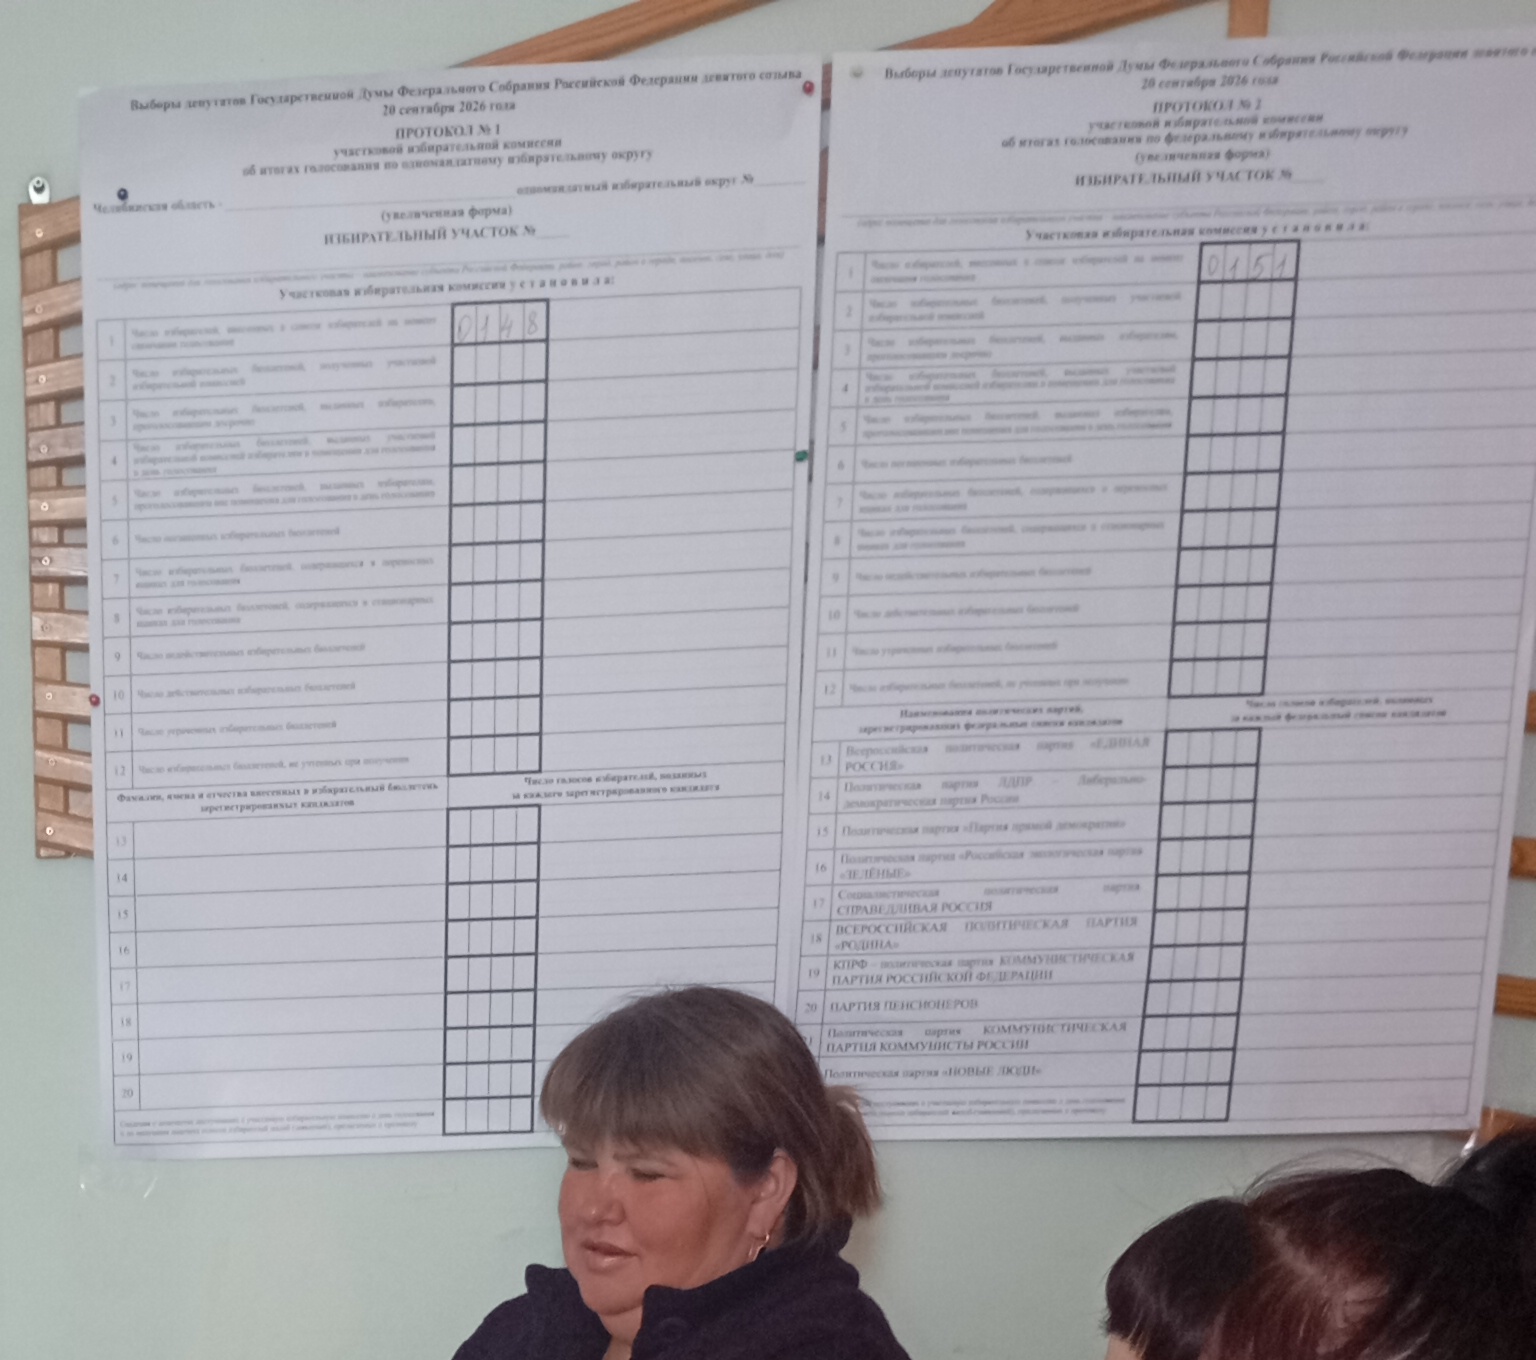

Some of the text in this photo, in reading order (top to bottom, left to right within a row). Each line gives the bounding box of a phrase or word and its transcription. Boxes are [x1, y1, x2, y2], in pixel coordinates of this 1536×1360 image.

[131, 99, 182, 111] Выборы
[185, 96, 246, 110] депутатов
[251, 91, 354, 106] Государственной
[359, 88, 393, 101] Думы
[397, 82, 486, 100] Федерального
[489, 80, 550, 94] Собрания
[554, 75, 625, 89] Российской
[383, 104, 395, 116] 20
[399, 101, 456, 117] сентября
[460, 100, 486, 112] 2026
[395, 124, 473, 140] ПРОТОКОЛ
[451, 226, 518, 241] УЧАСТОК
